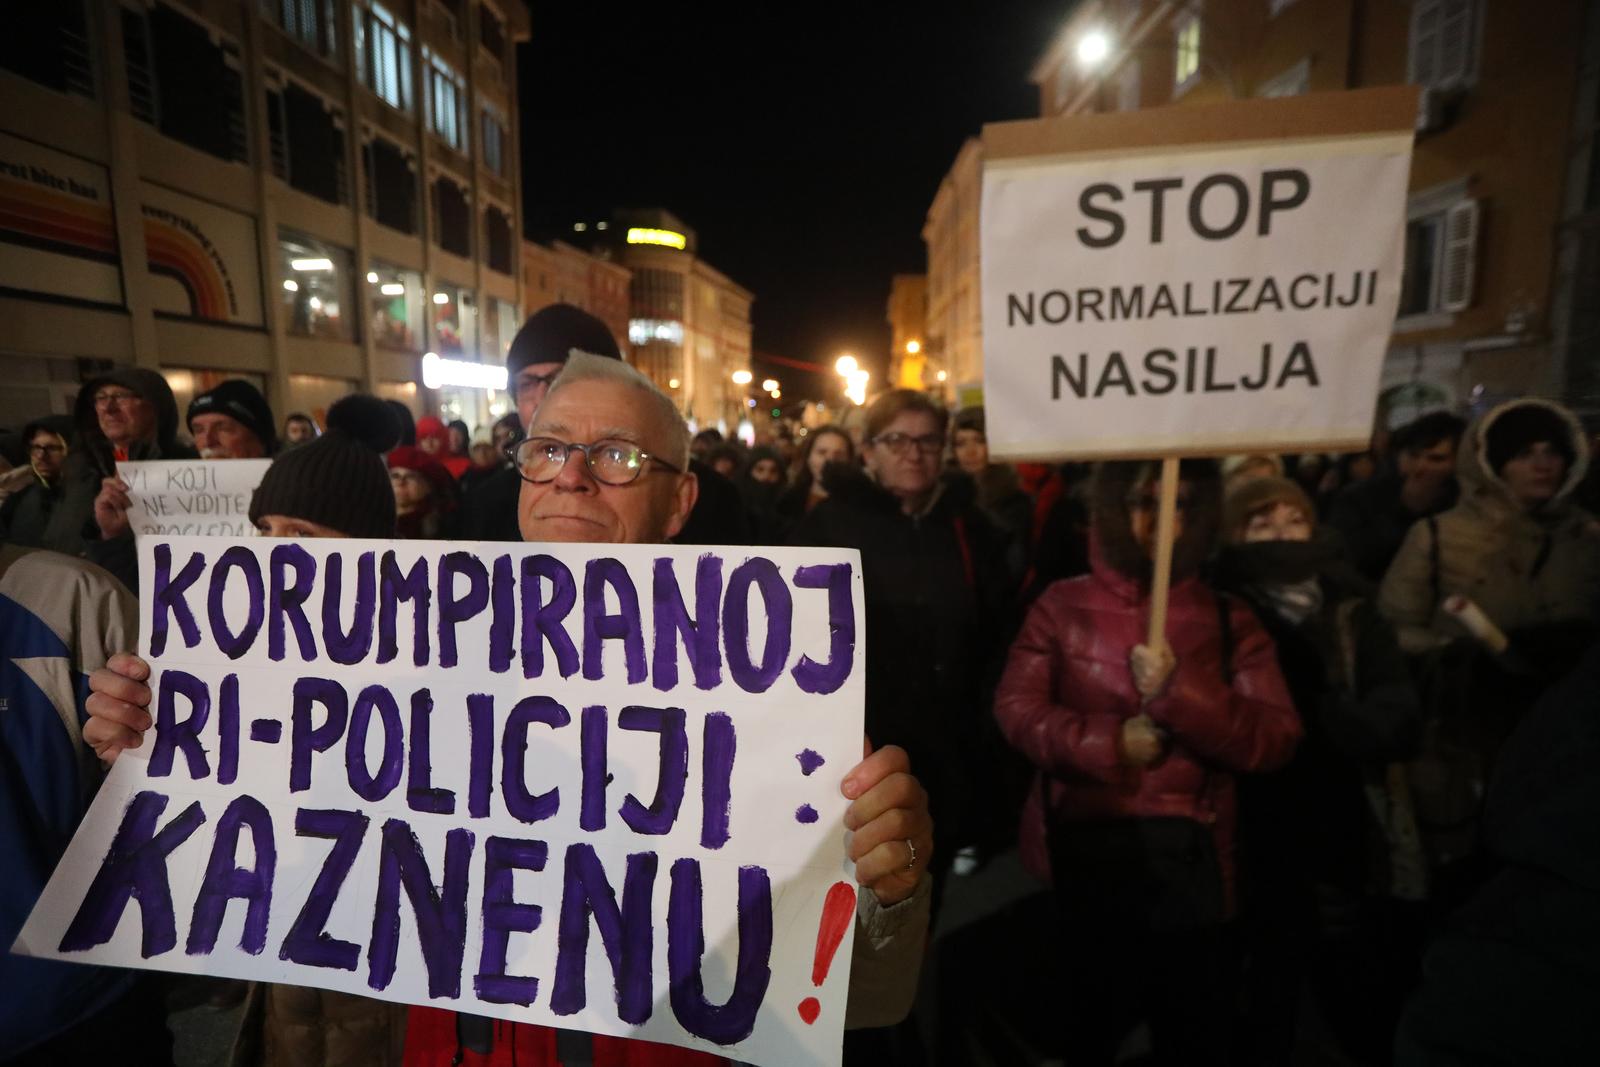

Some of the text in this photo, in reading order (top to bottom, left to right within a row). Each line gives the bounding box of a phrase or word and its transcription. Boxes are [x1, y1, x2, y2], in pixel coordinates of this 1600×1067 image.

[1076, 168, 1311, 249] STOP
[1007, 269, 1378, 328] NORMALIZACIJI
[1051, 341, 1320, 401] NASILJA
[123, 465, 217, 491] VI KOJI
[143, 493, 246, 517] NE VIDITE
[150, 543, 856, 695] KORUMPIRANOJ
[146, 669, 737, 850] RI-POLICIJI
[58, 790, 773, 1046] KAZNENU
